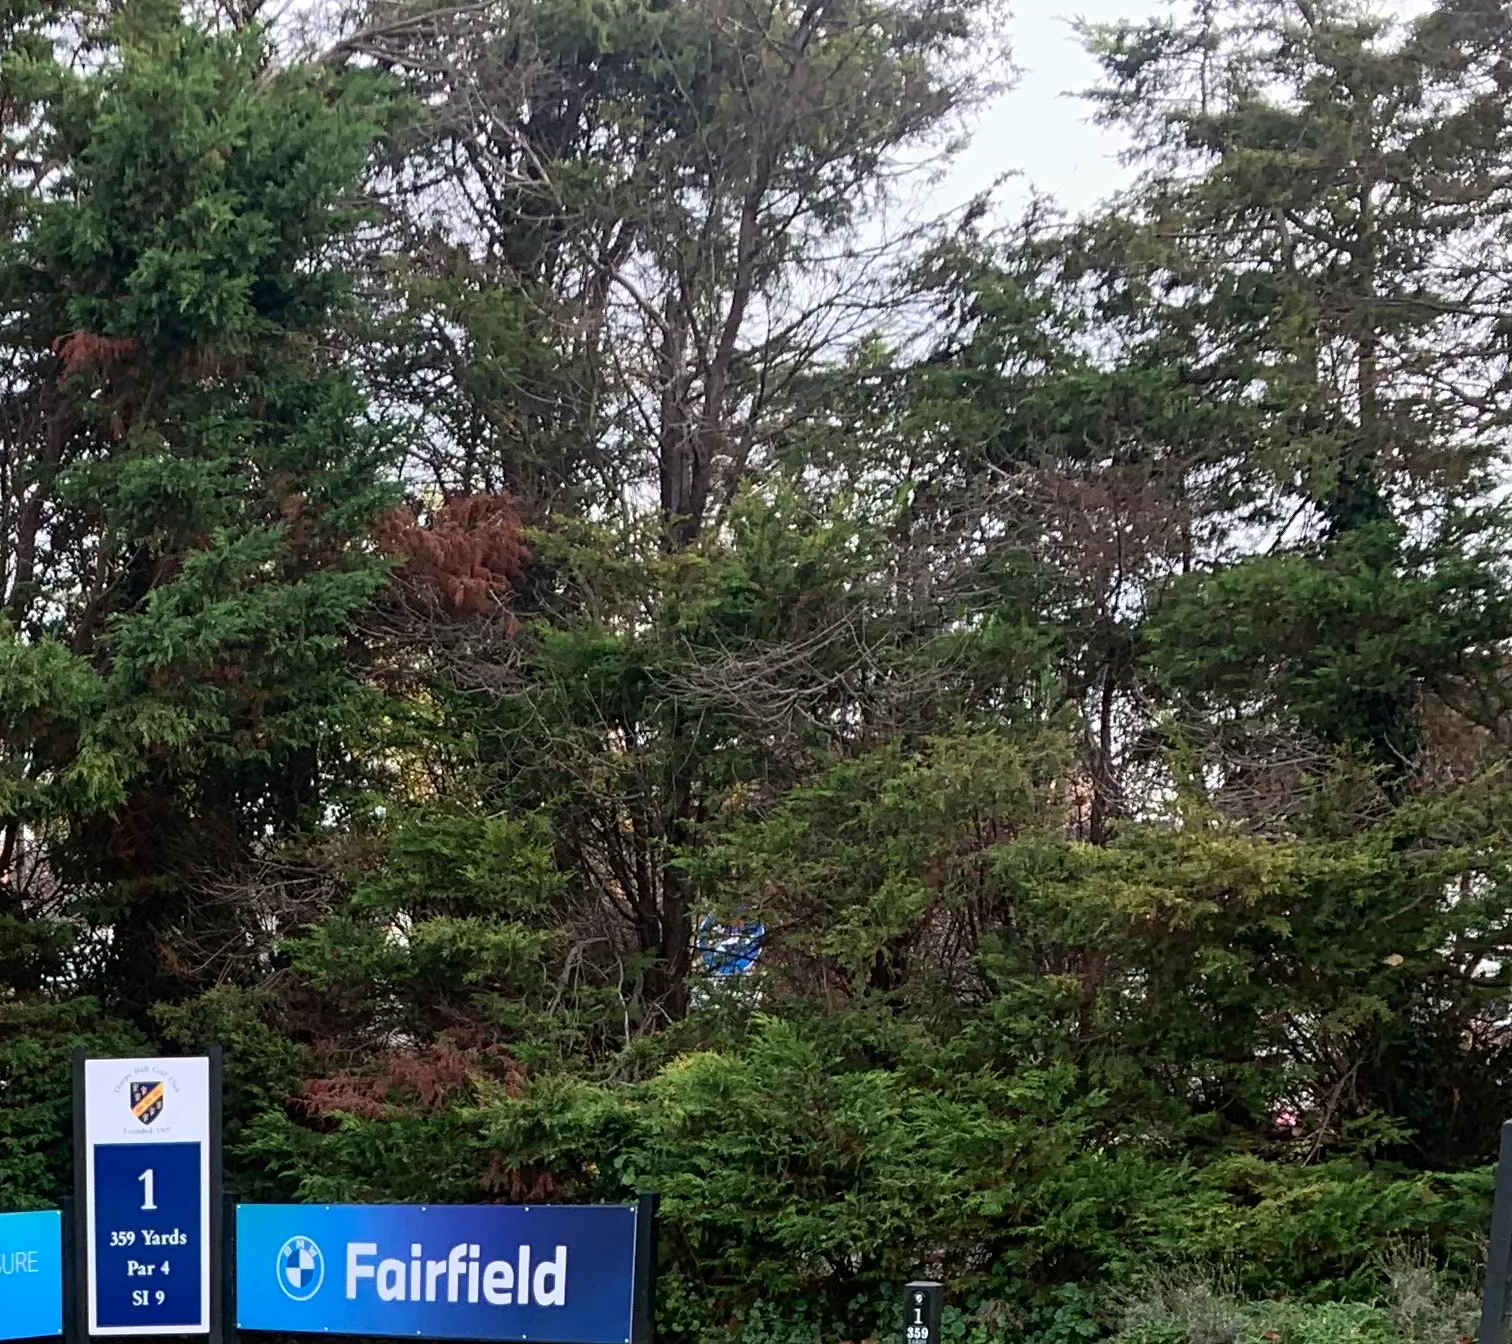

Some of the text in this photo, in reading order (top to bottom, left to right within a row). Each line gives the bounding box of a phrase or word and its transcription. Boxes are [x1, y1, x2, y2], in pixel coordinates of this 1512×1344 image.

[137, 1168, 158, 1210] 1
[109, 1229, 188, 1247] 359 Yards
[282, 1239, 318, 1258] BMW
[126, 1260, 170, 1276] Par 4
[345, 1242, 568, 1307] Fairfield
[132, 1290, 166, 1307] SI 9
[913, 1308, 924, 1324] 1
[906, 1326, 929, 1339] 359
